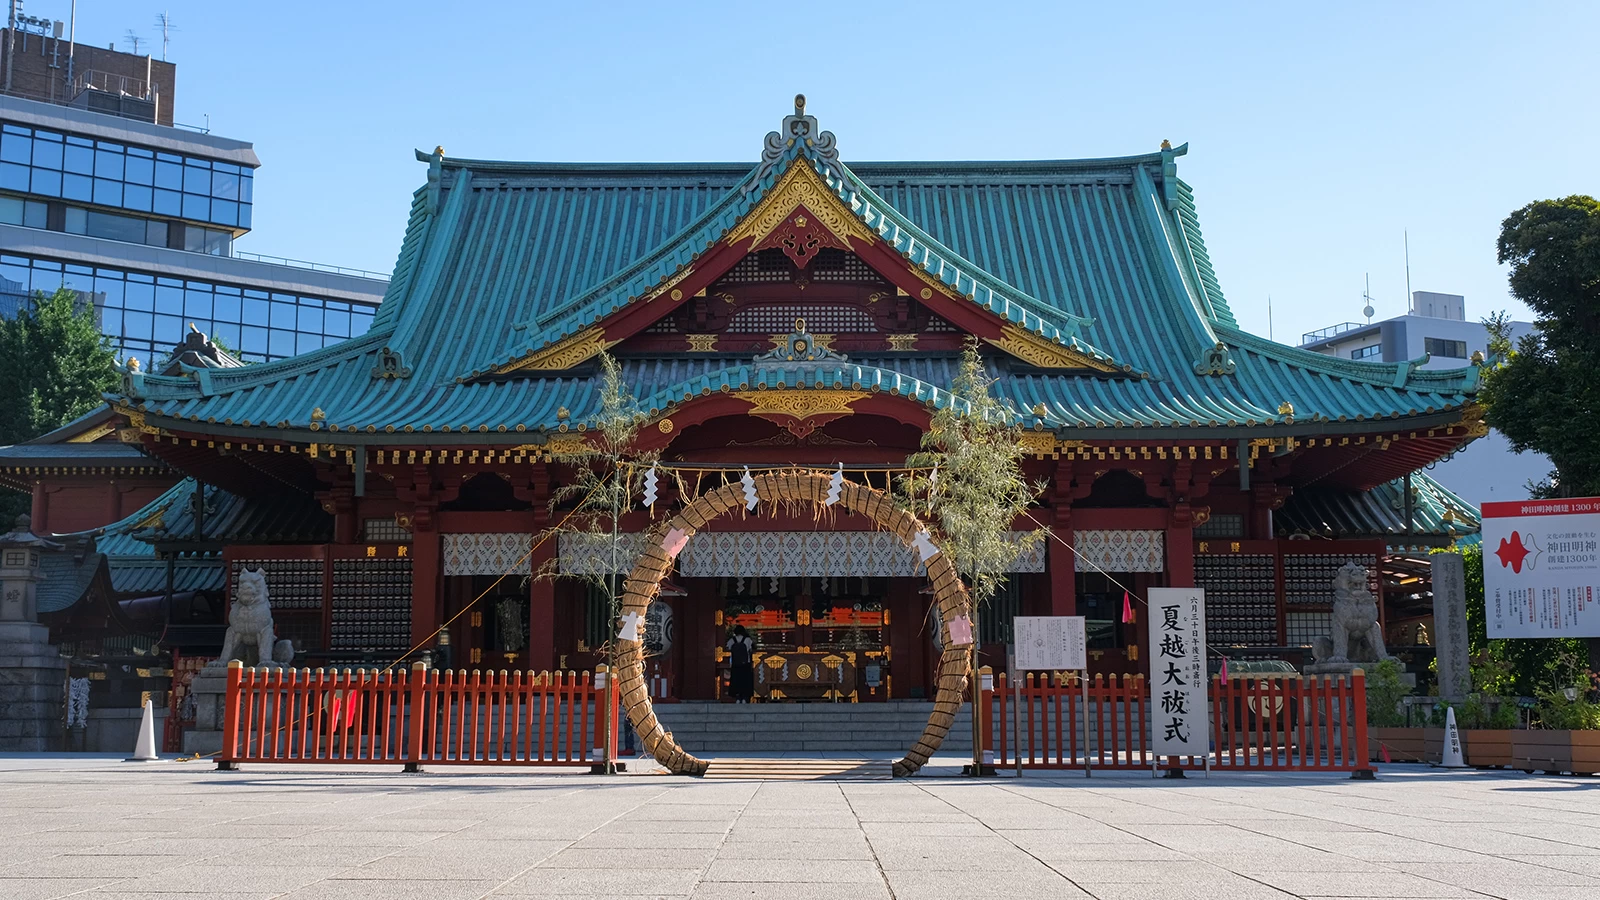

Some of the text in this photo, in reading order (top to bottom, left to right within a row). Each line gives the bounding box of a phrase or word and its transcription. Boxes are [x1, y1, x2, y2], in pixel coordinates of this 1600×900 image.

[1521, 504, 1569, 514] 神田明神創建
[1571, 503, 1591, 511] 1300
[1547, 540, 1597, 553] 神田明神
[1547, 554, 1598, 564] 創建1300年
[1159, 604, 1187, 743] 夏越大祓式
[1449, 723, 1459, 754] 神田明神
